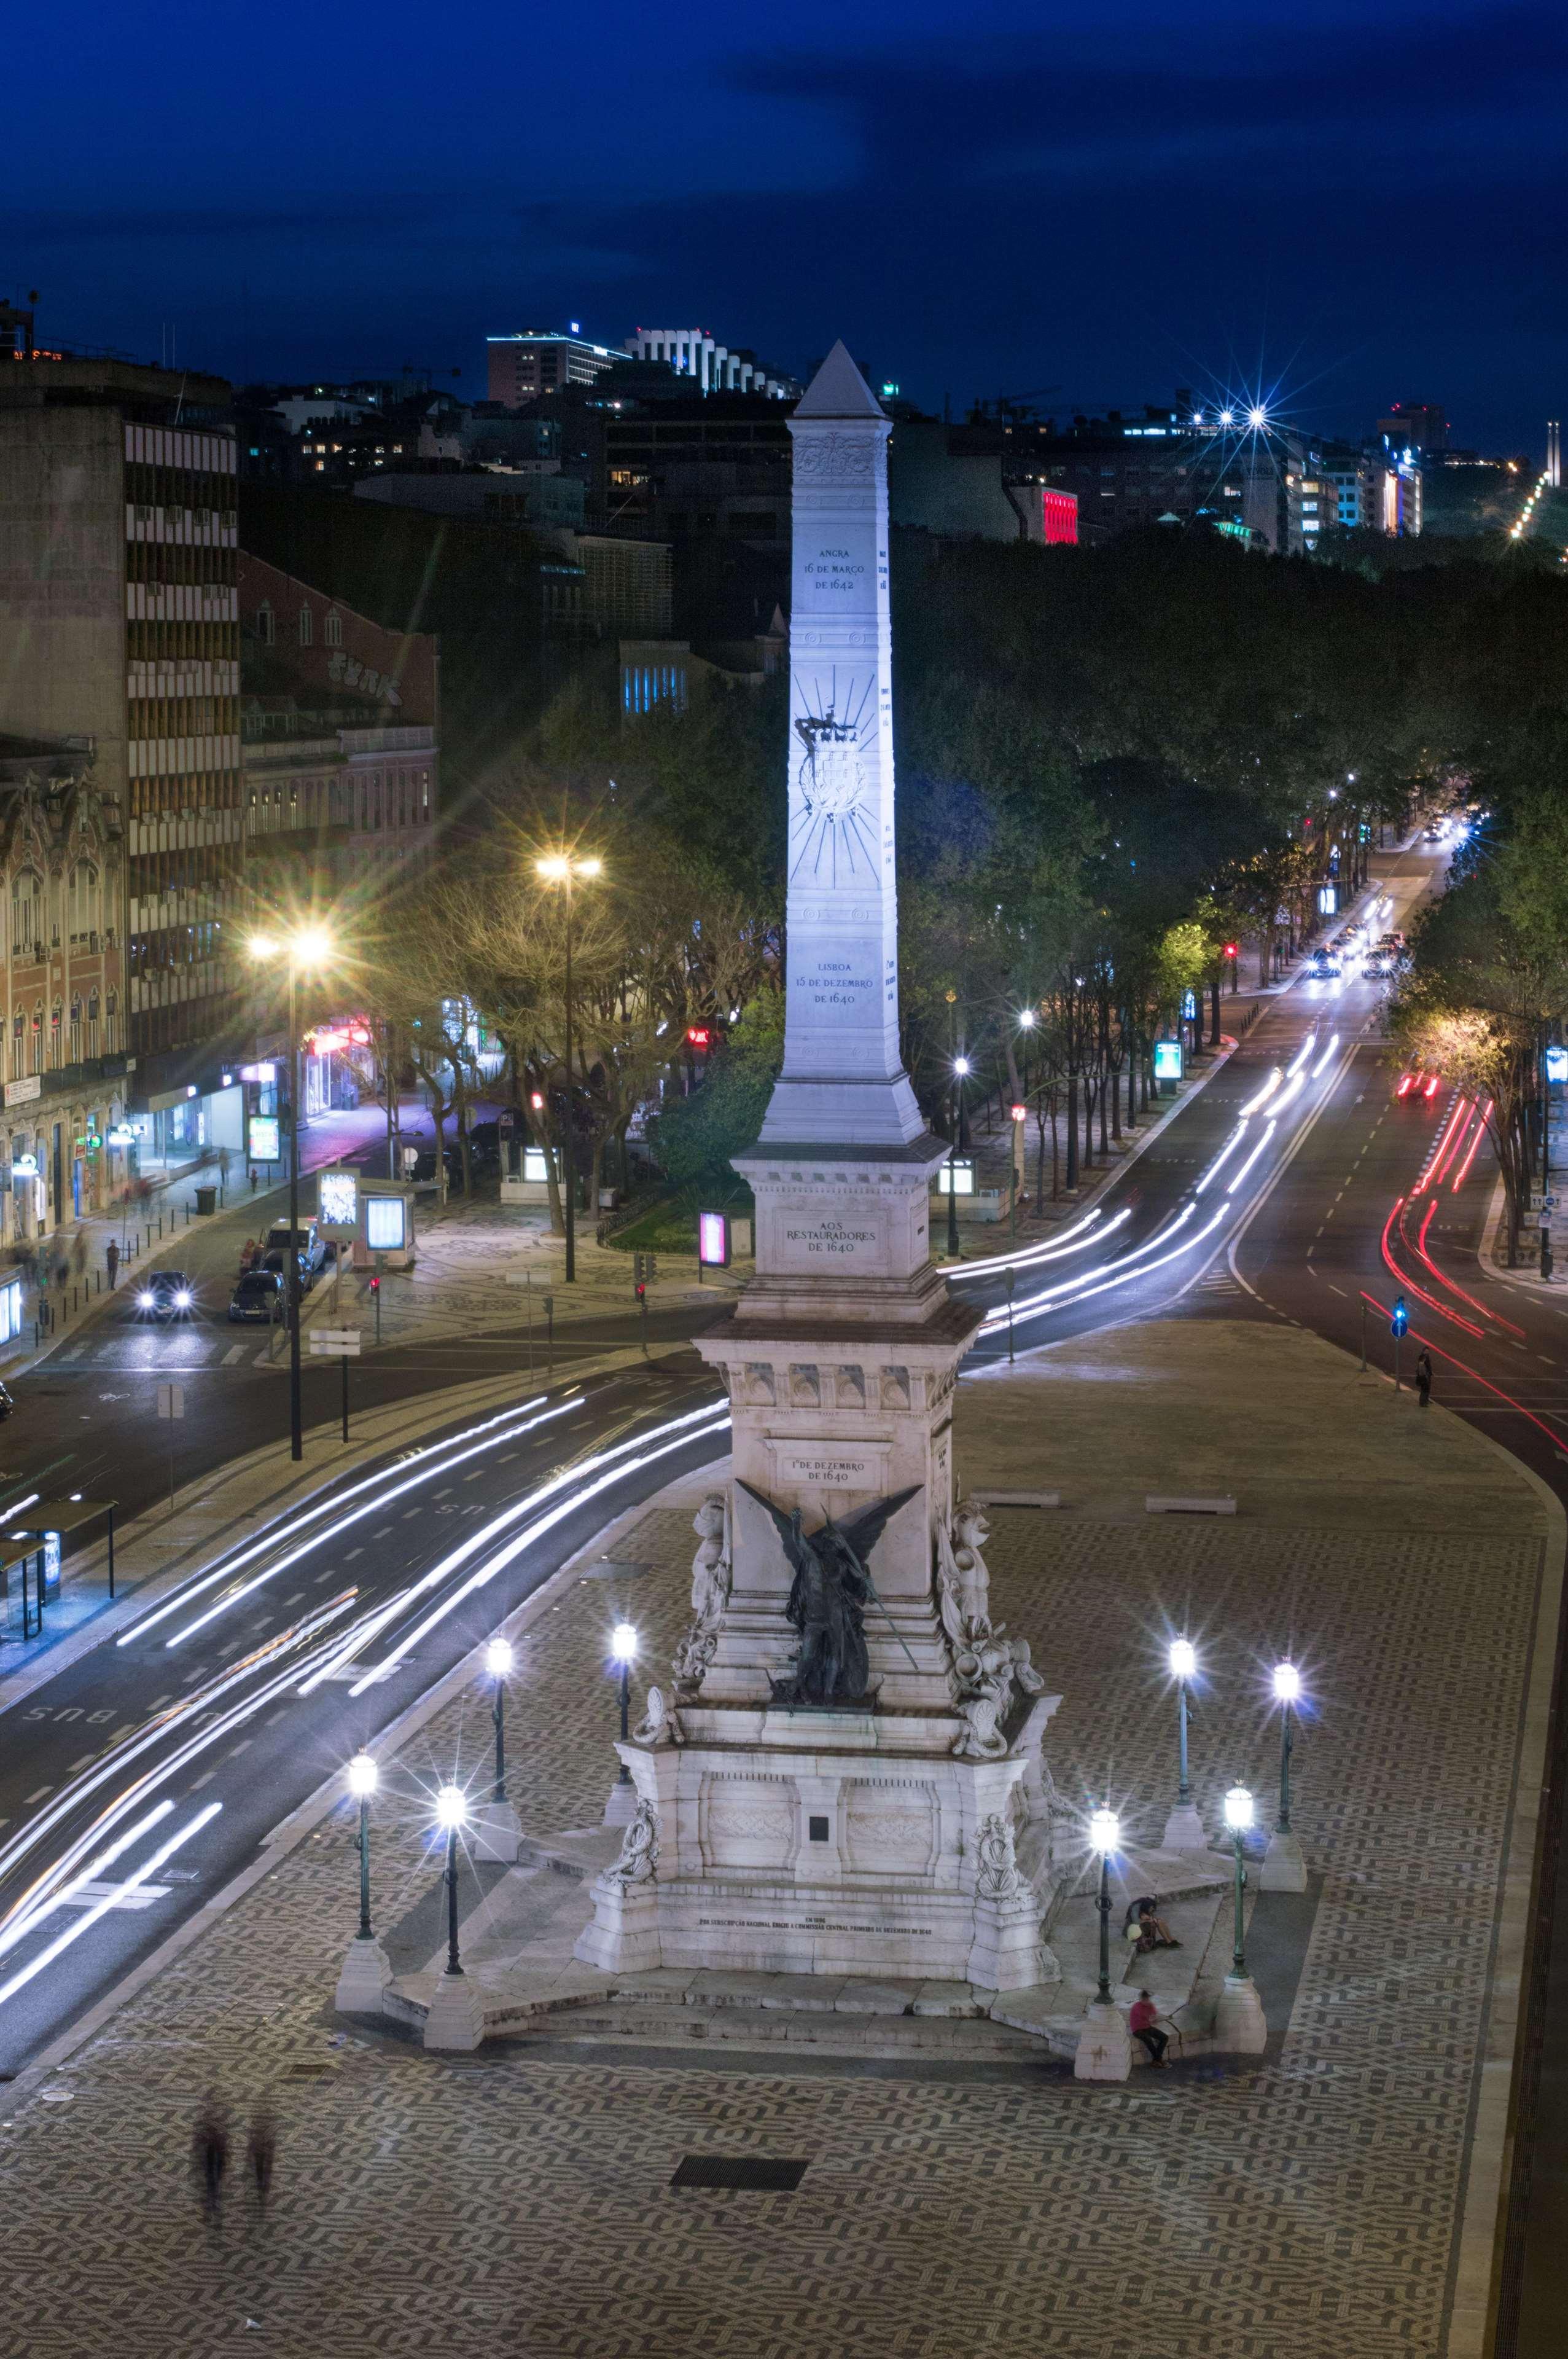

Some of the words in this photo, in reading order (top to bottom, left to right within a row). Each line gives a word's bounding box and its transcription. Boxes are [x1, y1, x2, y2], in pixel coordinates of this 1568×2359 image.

[819, 550, 849, 558] ANGRA
[805, 563, 814, 573] 16
[832, 565, 864, 576] MARÇO
[830, 579, 853, 591] 1642
[796, 977, 805, 987] 15
[824, 979, 873, 989] DEZEMBRO
[830, 992, 854, 1005] 1640
[787, 1230, 875, 1242] RESTAURADORES
[827, 1242, 854, 1253] 1640
[815, 1461, 864, 1472] DEZEMBRO
[824, 1470, 848, 1482] 1640
[23, 1707, 118, 1724] BUS
